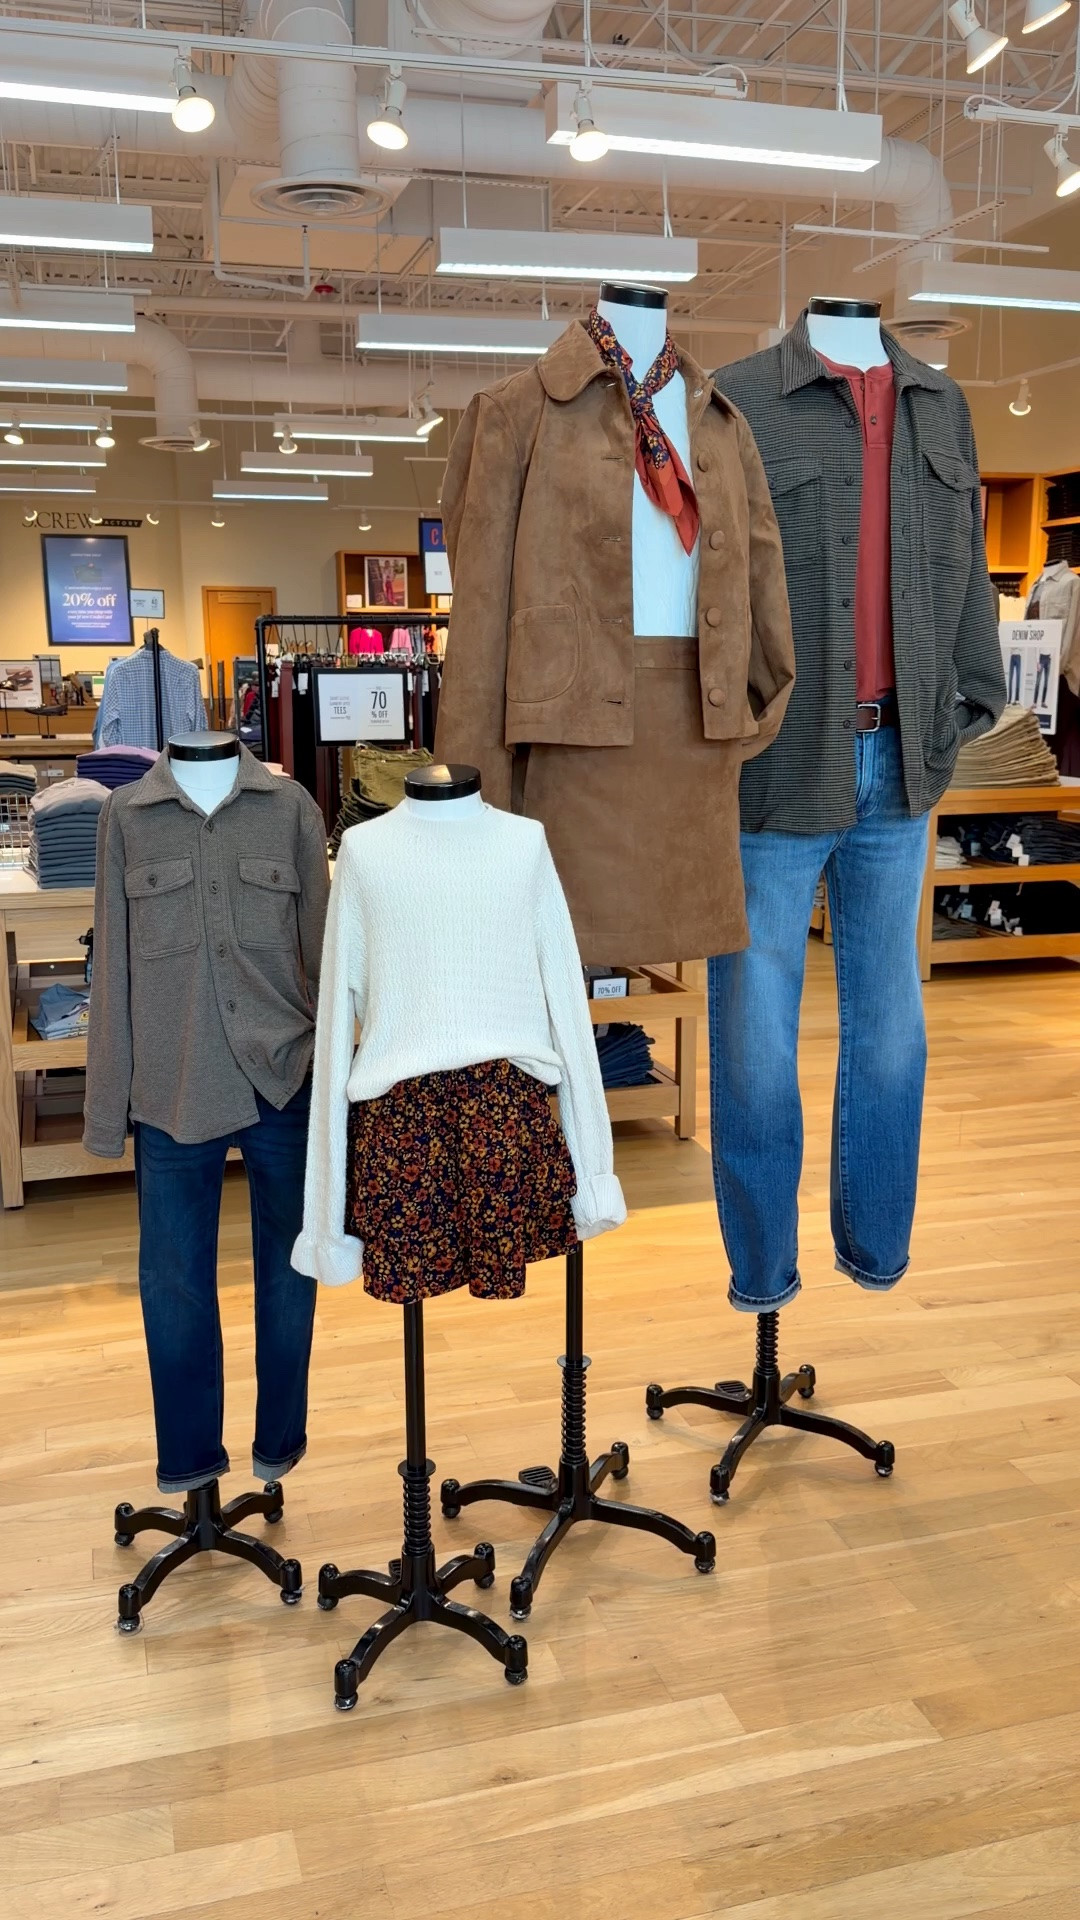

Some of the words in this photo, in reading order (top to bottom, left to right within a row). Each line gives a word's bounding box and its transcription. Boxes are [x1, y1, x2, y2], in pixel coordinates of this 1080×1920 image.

[62, 592, 95, 607] 20%
[97, 593, 117, 607] off
[1012, 630, 1028, 641] DENIM
[1029, 630, 1044, 641] SHOP
[371, 690, 387, 710] 70
[333, 706, 347, 715] TEES
[371, 710, 377, 719] %
[378, 710, 388, 719] OFF
[597, 987, 610, 995] 70%
